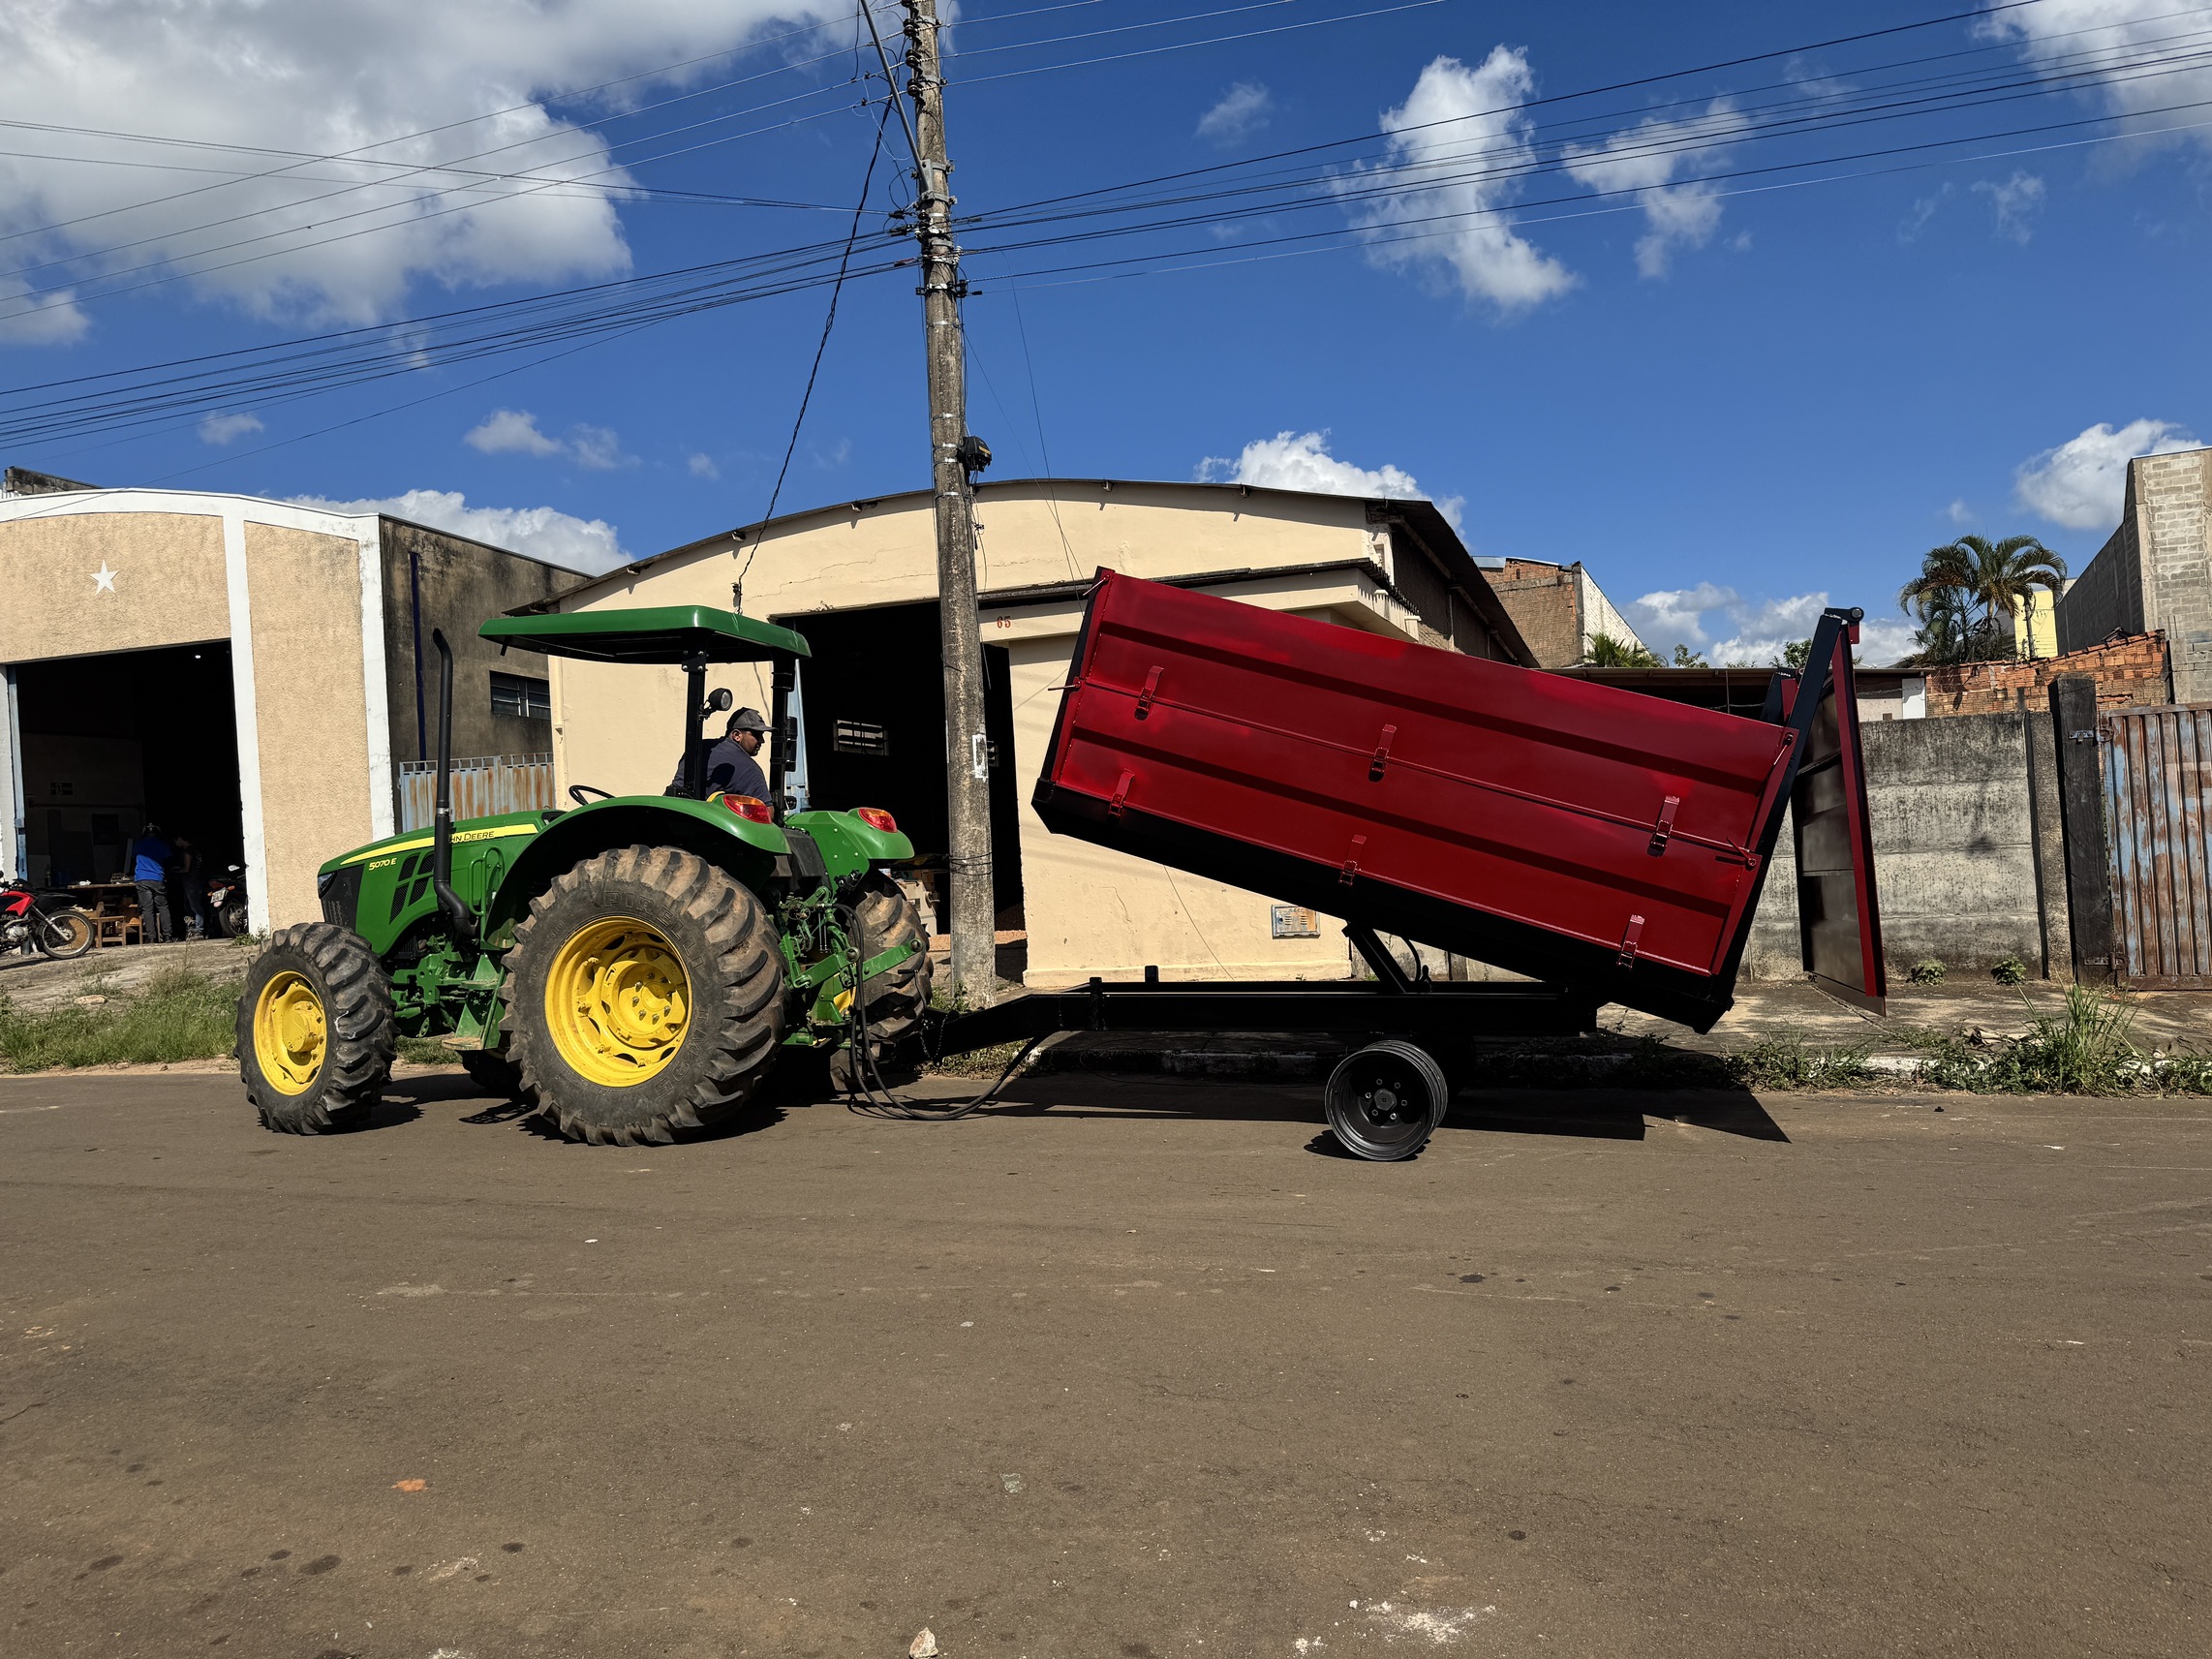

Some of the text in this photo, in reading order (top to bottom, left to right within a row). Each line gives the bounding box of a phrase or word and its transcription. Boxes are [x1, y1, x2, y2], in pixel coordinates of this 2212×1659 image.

[997, 616, 1011, 629] 65
[464, 830, 495, 842] DEERE
[603, 891, 704, 968] PIRELLI
